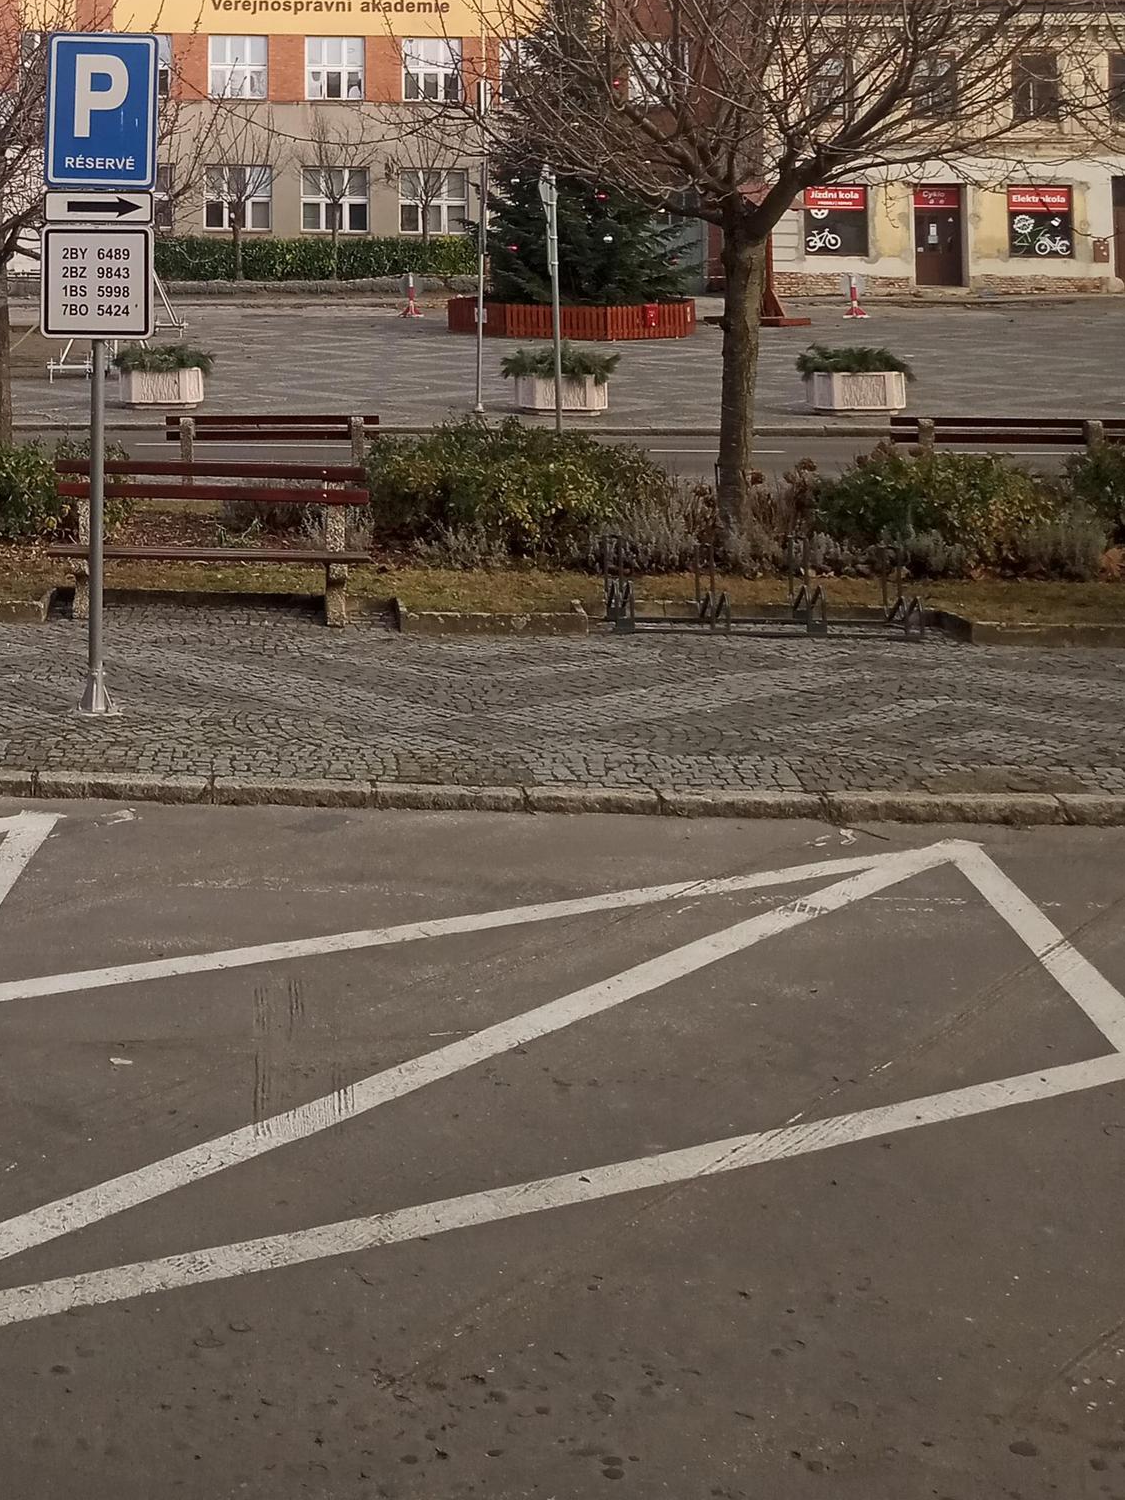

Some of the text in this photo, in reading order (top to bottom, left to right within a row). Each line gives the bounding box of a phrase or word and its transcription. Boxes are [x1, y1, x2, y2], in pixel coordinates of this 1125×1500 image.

[74, 53, 129, 137] P
[65, 155, 135, 170] RÉSERVÉ
[838, 190, 860, 199] kola
[62, 247, 130, 260] 2BY 6489
[62, 266, 130, 279] 2BZ 9843
[62, 285, 130, 298] 1BS 5998
[61, 303, 130, 317] 7BO 5424
